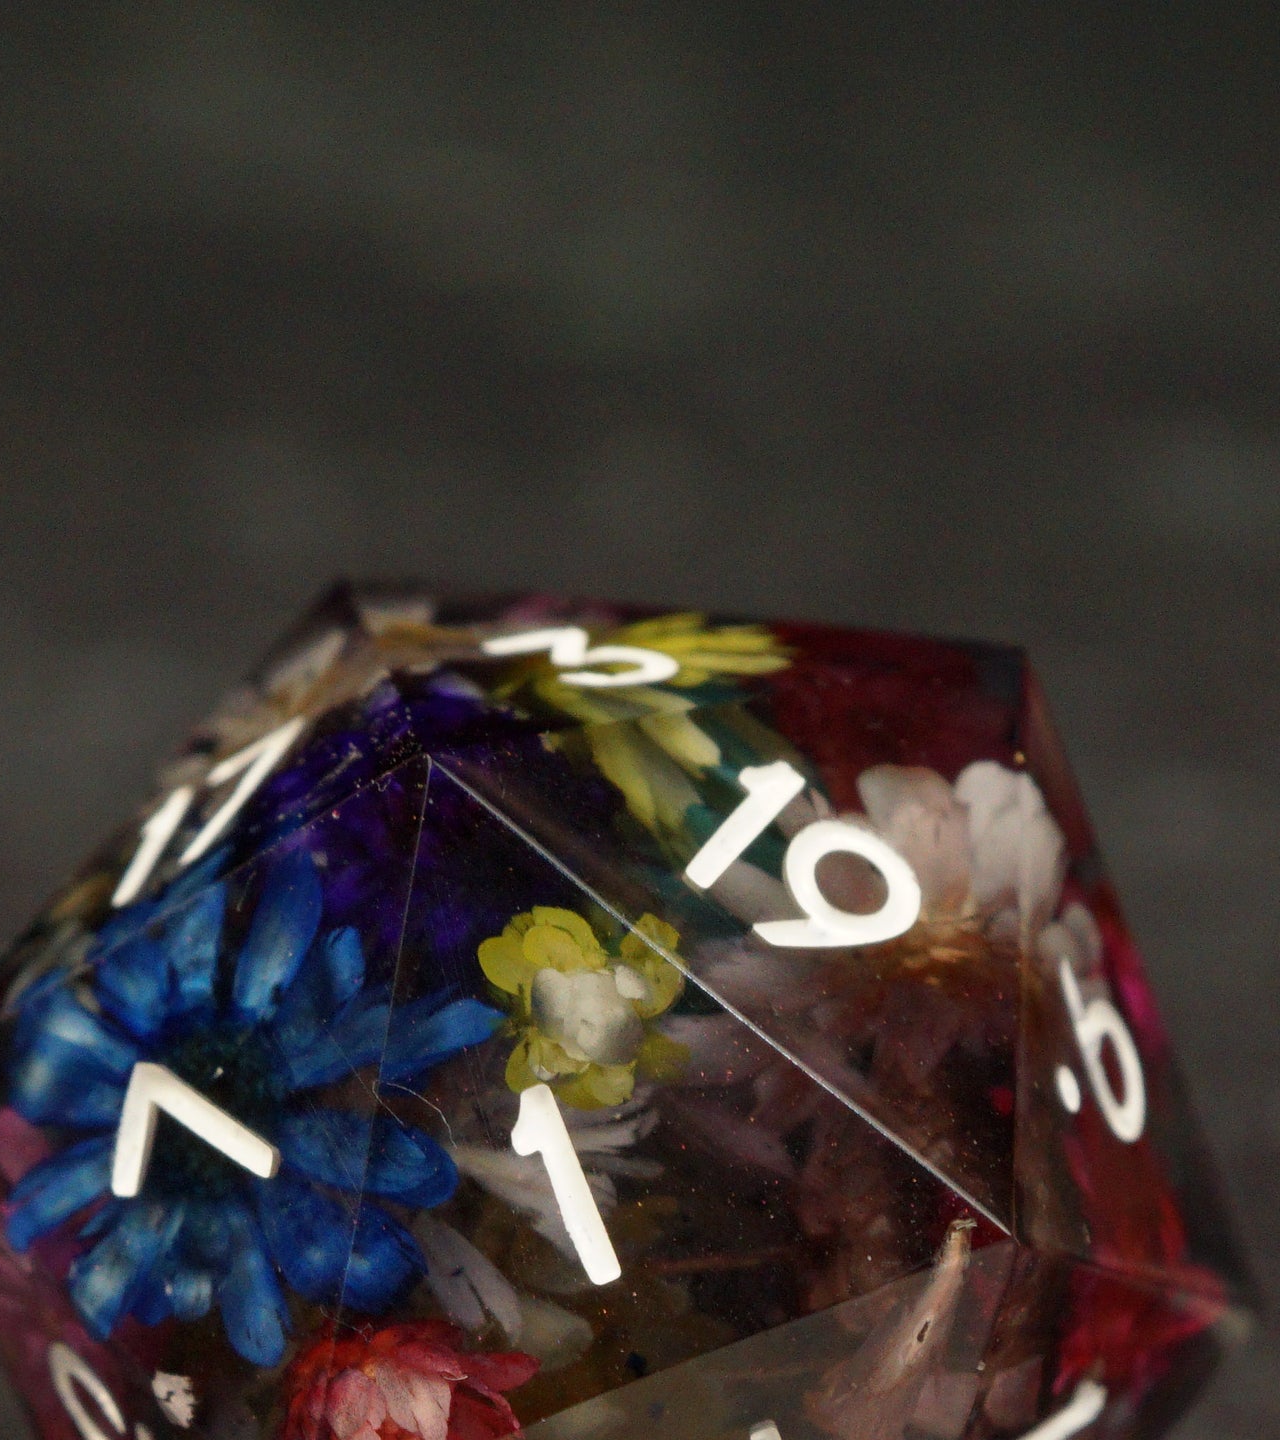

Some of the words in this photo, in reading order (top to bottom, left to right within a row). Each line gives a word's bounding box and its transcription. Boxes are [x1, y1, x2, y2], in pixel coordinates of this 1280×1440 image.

[113, 718, 305, 906] 17
[684, 760, 924, 948] 19
[111, 1062, 275, 1197] 7
[510, 1084, 621, 1285] 1
